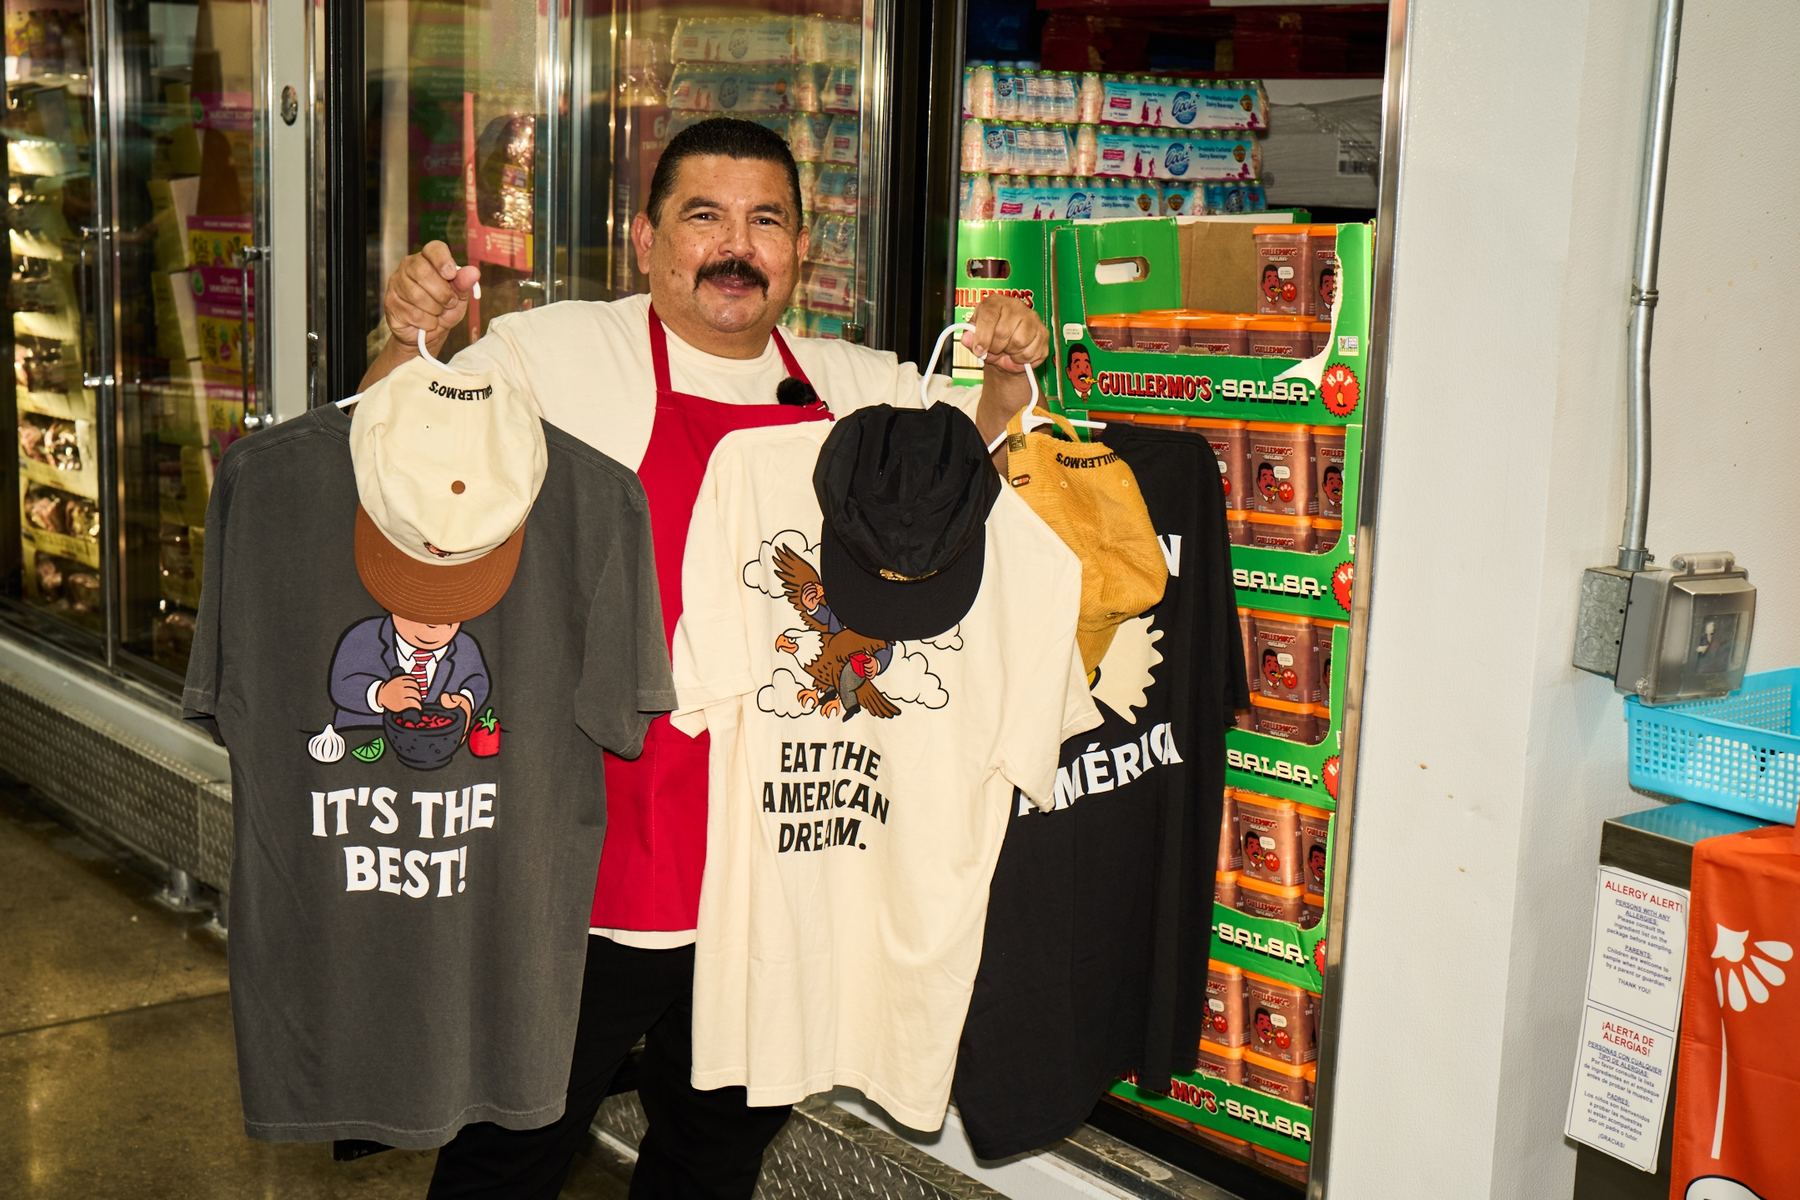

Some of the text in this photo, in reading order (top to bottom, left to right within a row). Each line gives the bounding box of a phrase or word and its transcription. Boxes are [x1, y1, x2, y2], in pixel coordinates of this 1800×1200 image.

[1098, 371, 1213, 403] GUILLERMO'S
[1327, 370, 1353, 388] HOT
[780, 741, 881, 781] EAT THE
[311, 783, 497, 838] IT'S THE
[762, 779, 890, 825] AMERICAN
[778, 817, 867, 853] DREAM.
[343, 846, 468, 899] BEST!
[1605, 881, 1683, 912] ALLERGY ALERT!
[1616, 899, 1670, 922] PERSONS WITH ANY
[1607, 928, 1628, 940] package
[1630, 934, 1646, 944] before
[1615, 922, 1640, 935] ingredient
[1642, 930, 1650, 938] list
[1659, 935, 1667, 943] the
[1618, 915, 1665, 935] Please consult the
[1603, 954, 1671, 981] sample when accompanied
[1606, 962, 1612, 970] by
[1618, 967, 1634, 977] parent
[1607, 946, 1628, 958] Children
[1640, 958, 1662, 971] welcome
[1618, 978, 1636, 989] THANK
[1602, 1022, 1654, 1047] ¡ALERTA DE
[1603, 1032, 1650, 1056] ALERGIAS!
[1588, 1041, 1662, 1075] PERSONAS CON CUALQUIER
[1599, 1053, 1610, 1063] TIPO
[1587, 1073, 1600, 1082] antes
[1609, 1081, 1625, 1092] probar
[1592, 1065, 1622, 1082] ingredientes
[1636, 1084, 1660, 1098] empaque
[1601, 1061, 1614, 1071] favor
[1644, 1078, 1654, 1088] lista
[1594, 1104, 1610, 1114] probar
[1620, 1114, 1642, 1128] muestras
[1620, 1104, 1650, 1123] bienvenidos
[1606, 1124, 1620, 1135] padre
